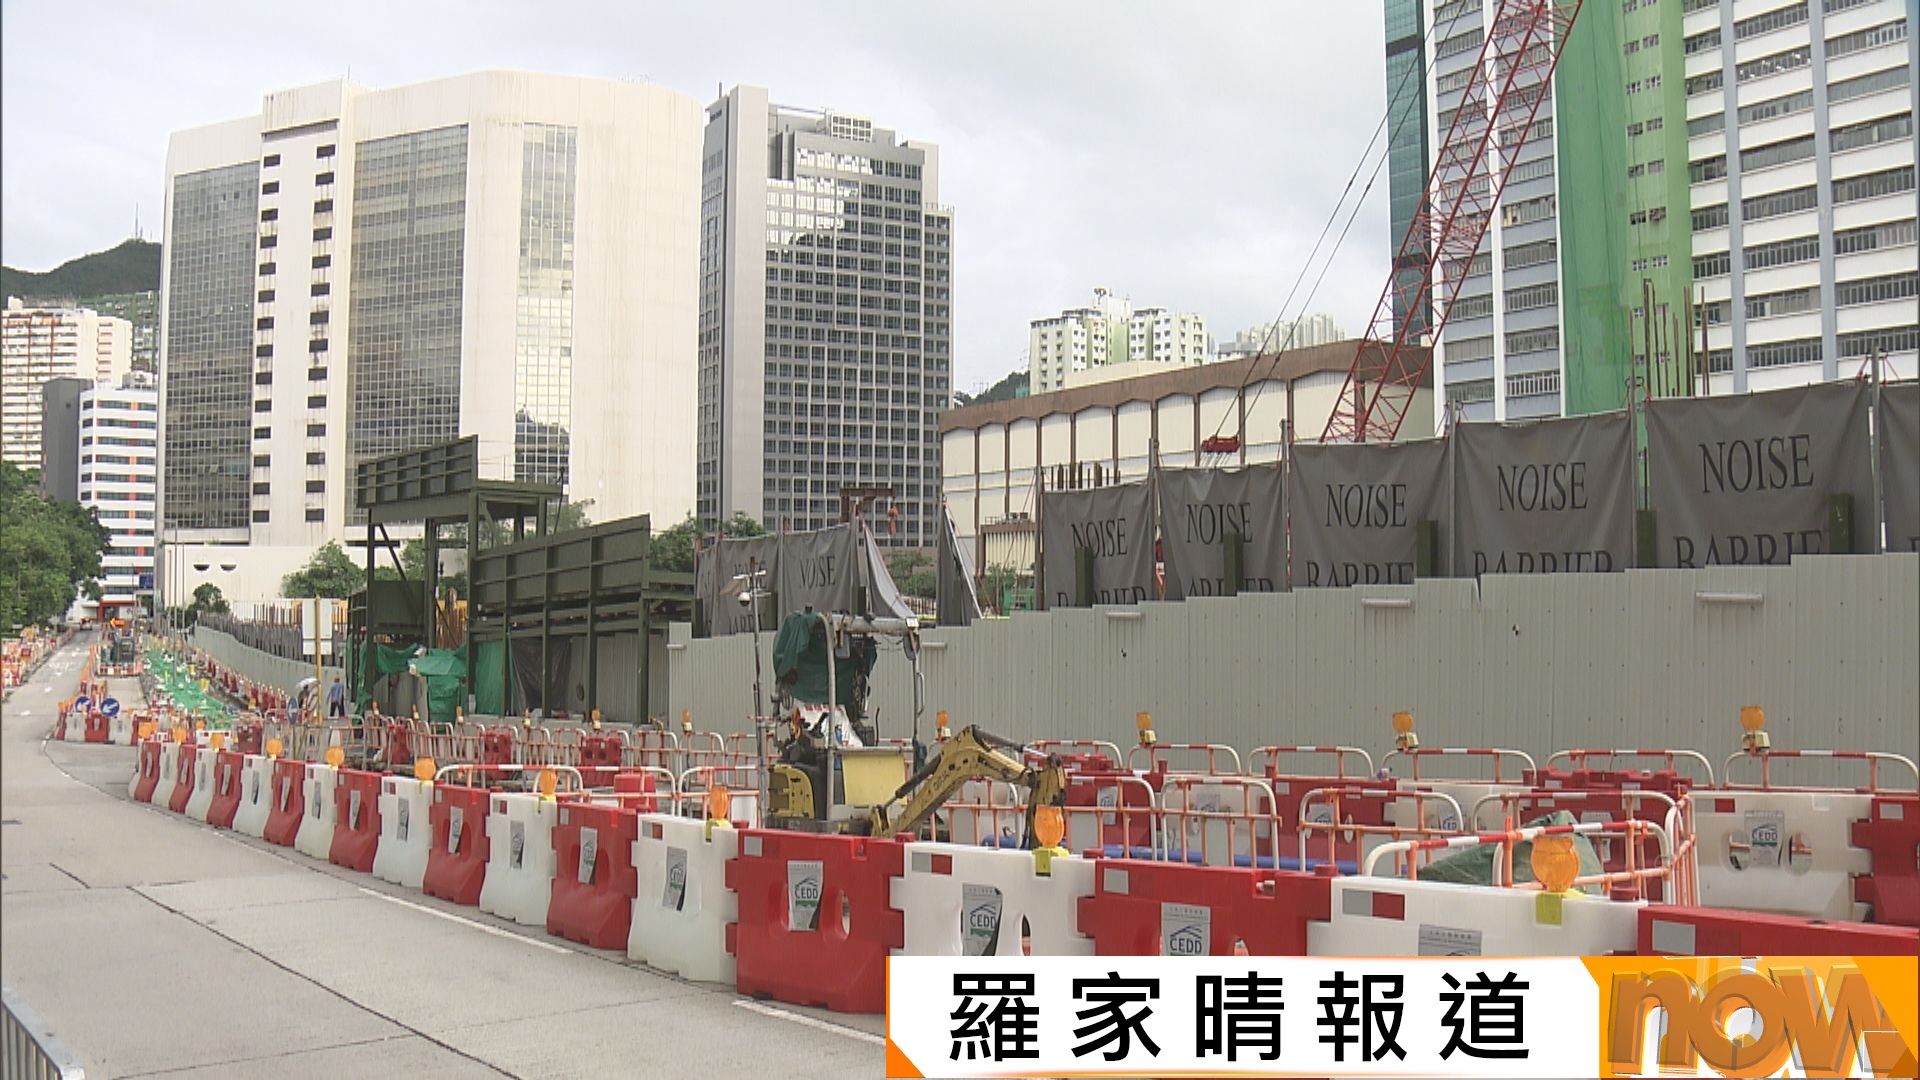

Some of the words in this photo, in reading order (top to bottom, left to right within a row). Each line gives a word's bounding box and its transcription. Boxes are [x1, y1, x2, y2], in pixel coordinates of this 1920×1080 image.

[1699, 434, 1814, 493] NOISE
[1326, 484, 1408, 529] NOISE
[1497, 462, 1588, 511] NOISE
[1071, 518, 1128, 559] NOISE
[1186, 502, 1253, 545] NOISE
[1674, 529, 1825, 568] BARRIE
[795, 886, 818, 899] CEDD
[970, 912, 996, 928] CEDD
[1170, 938, 1202, 953] CEDD
